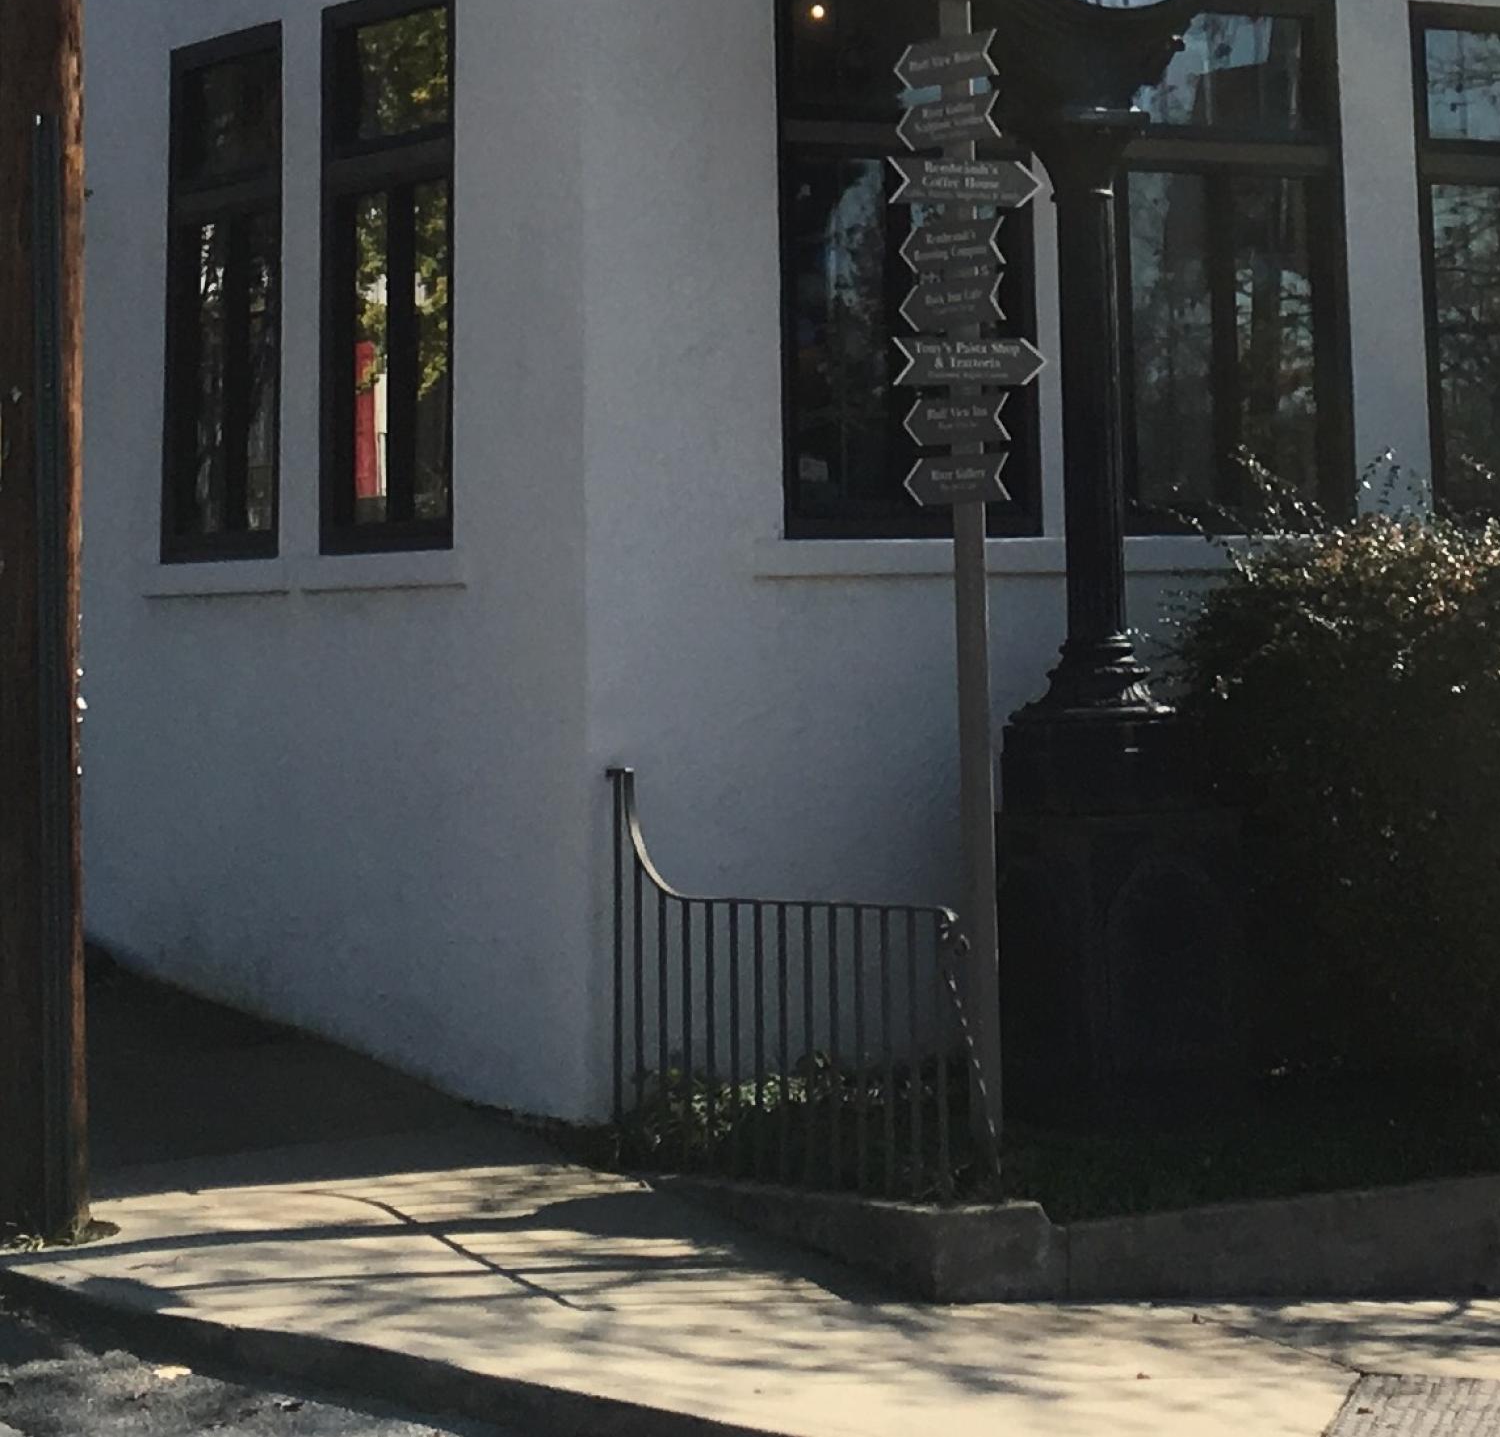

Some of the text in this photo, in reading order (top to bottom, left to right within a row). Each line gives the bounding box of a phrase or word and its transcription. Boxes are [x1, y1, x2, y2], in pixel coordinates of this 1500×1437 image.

[924, 160, 999, 175] Rembrandt's
[922, 176, 999, 189] Coffee House
[915, 341, 1020, 357] Tony's Pasta Shop
[934, 357, 1001, 369] & Trattoria
